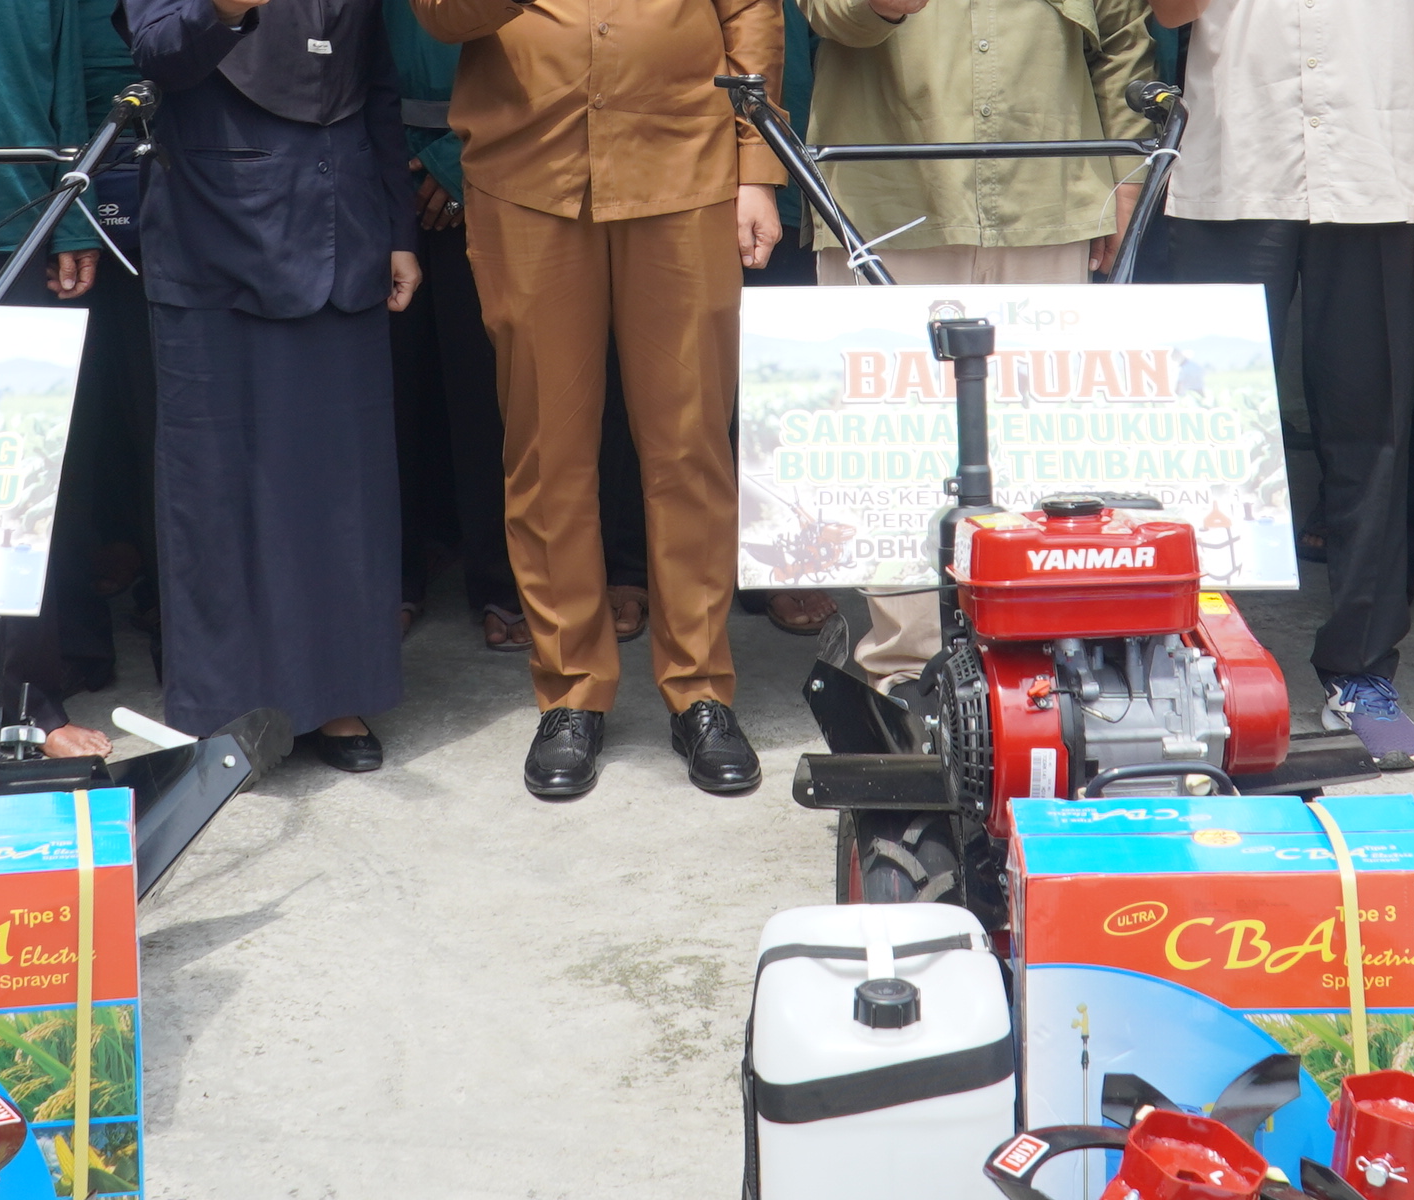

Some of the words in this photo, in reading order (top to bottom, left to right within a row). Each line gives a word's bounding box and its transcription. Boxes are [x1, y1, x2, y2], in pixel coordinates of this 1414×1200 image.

[783, 411, 957, 445] SARANA
[776, 450, 959, 482] BUDIDAY
[1009, 449, 1247, 480] TEMBAKAU
[818, 490, 890, 506] DINAS
[898, 490, 1043, 506] KETANAN
[1162, 490, 1210, 505] DAN
[1027, 547, 1155, 571] YANMAR
[10, 907, 54, 929] Tipe
[60, 906, 71, 922] 3
[1117, 908, 1157, 928] ULTRA
[1383, 904, 1397, 923] 3
[1164, 916, 1337, 974] CBA
[0, 971, 70, 990] Sprayer
[1321, 972, 1394, 991] Spryer
[1005, 1140, 1038, 1168] KIRI
